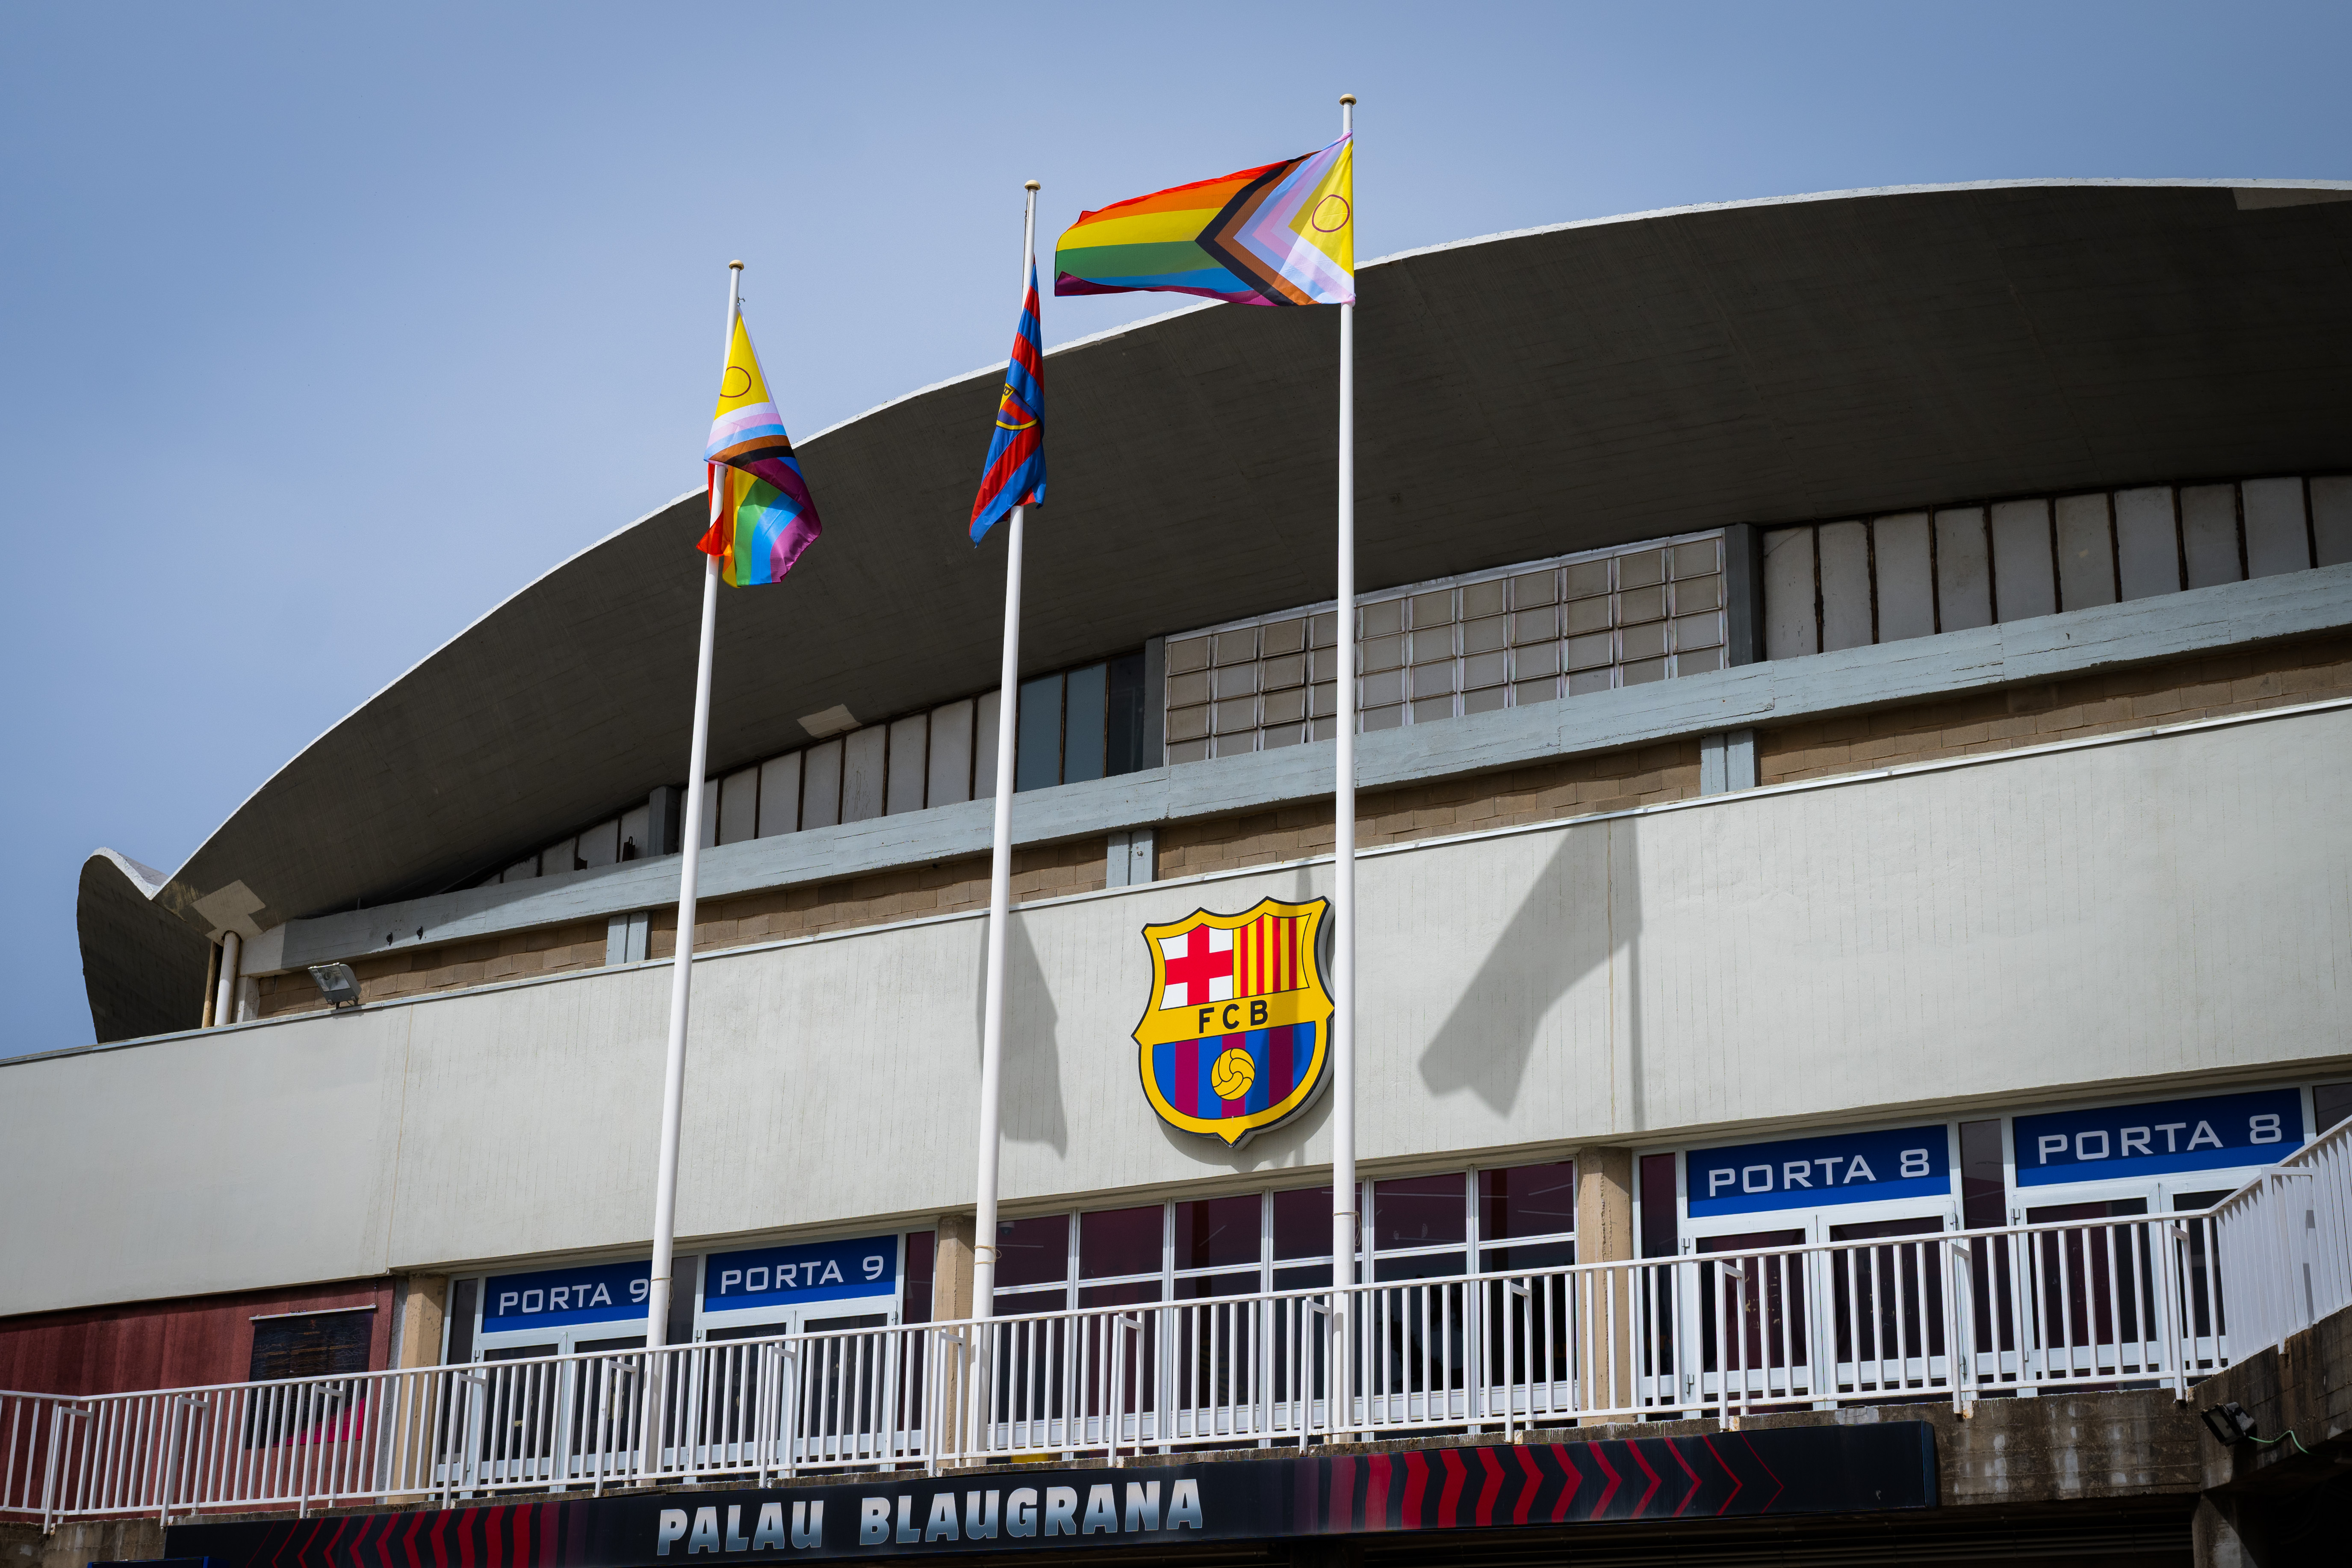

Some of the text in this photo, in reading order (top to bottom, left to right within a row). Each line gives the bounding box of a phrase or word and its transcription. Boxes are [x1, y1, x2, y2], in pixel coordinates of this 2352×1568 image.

[1198, 1000, 1269, 1034] FCB
[2038, 1113, 2282, 1164] PORTA 8
[1709, 1149, 1930, 1197] PORTA 8
[721, 1255, 883, 1294] PORTA 9
[499, 1279, 649, 1315] PORTA 9
[657, 1478, 1203, 1556] PALAU BLAUGRANA
